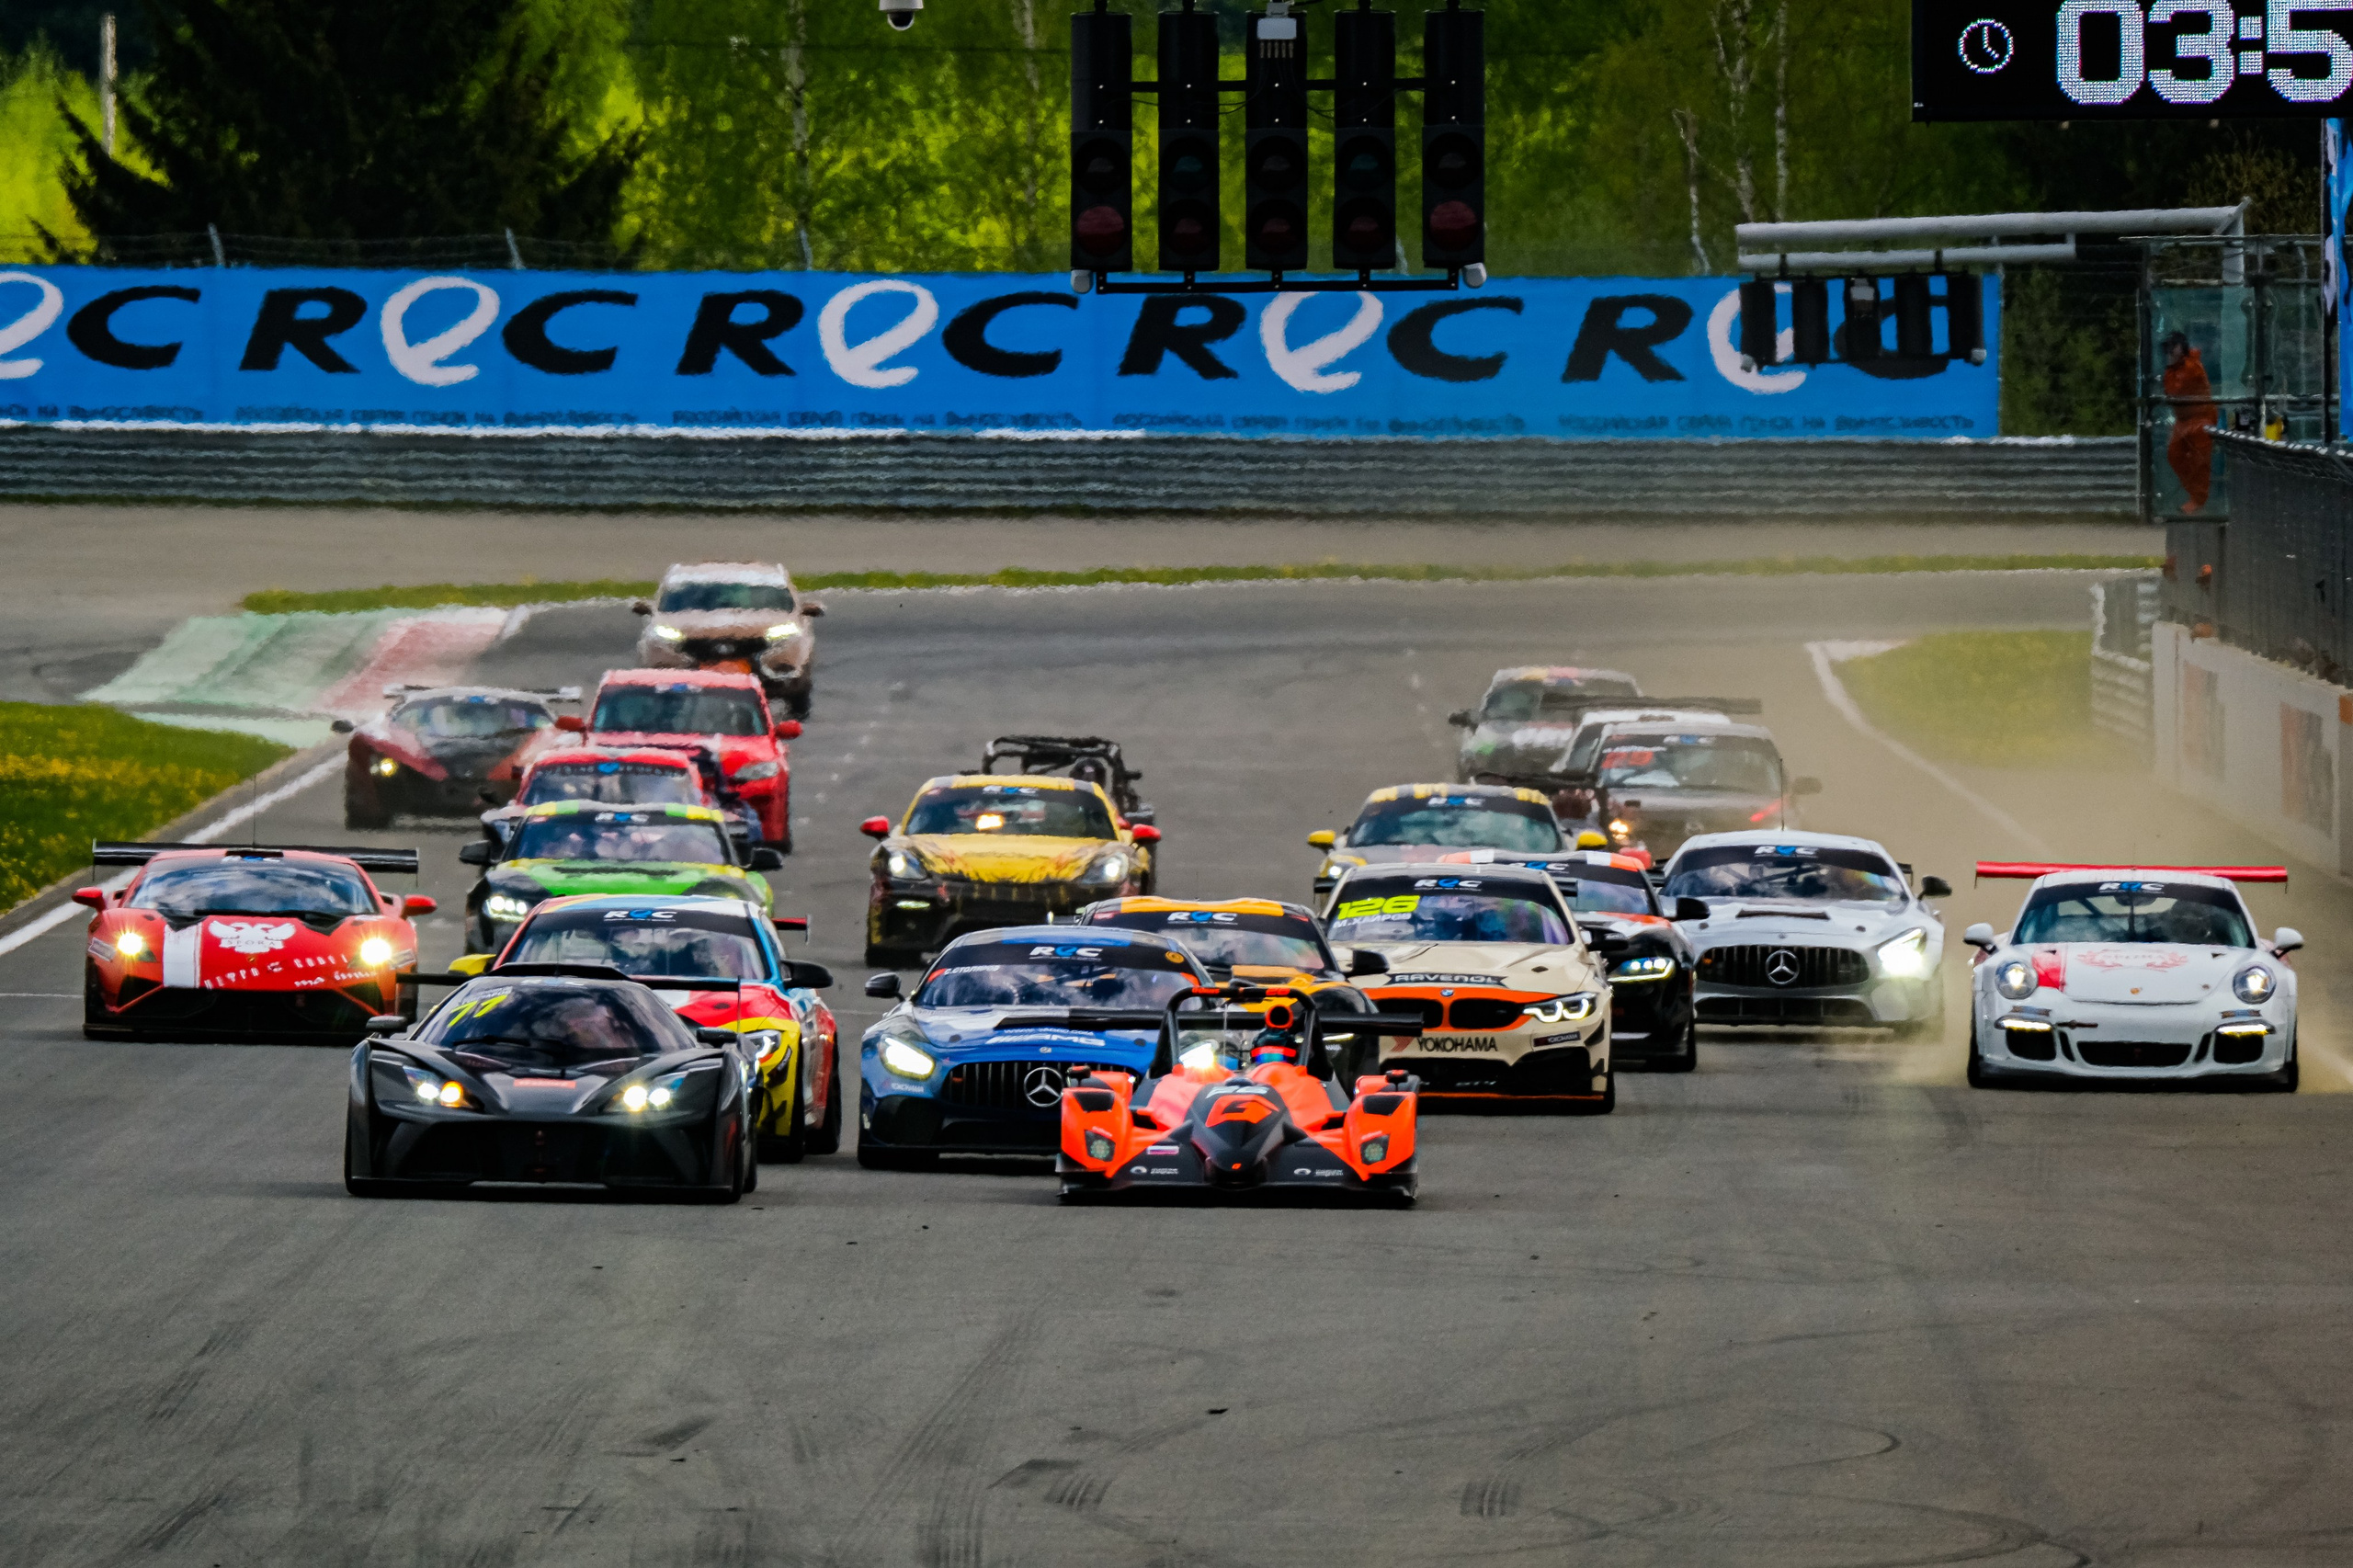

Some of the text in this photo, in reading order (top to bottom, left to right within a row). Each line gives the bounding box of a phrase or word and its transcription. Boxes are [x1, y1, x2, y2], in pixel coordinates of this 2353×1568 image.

[1338, 895, 1420, 920] 126
[1394, 974, 1498, 983] RAVENOL
[1416, 1036, 1498, 1052] YOKOHAMA
